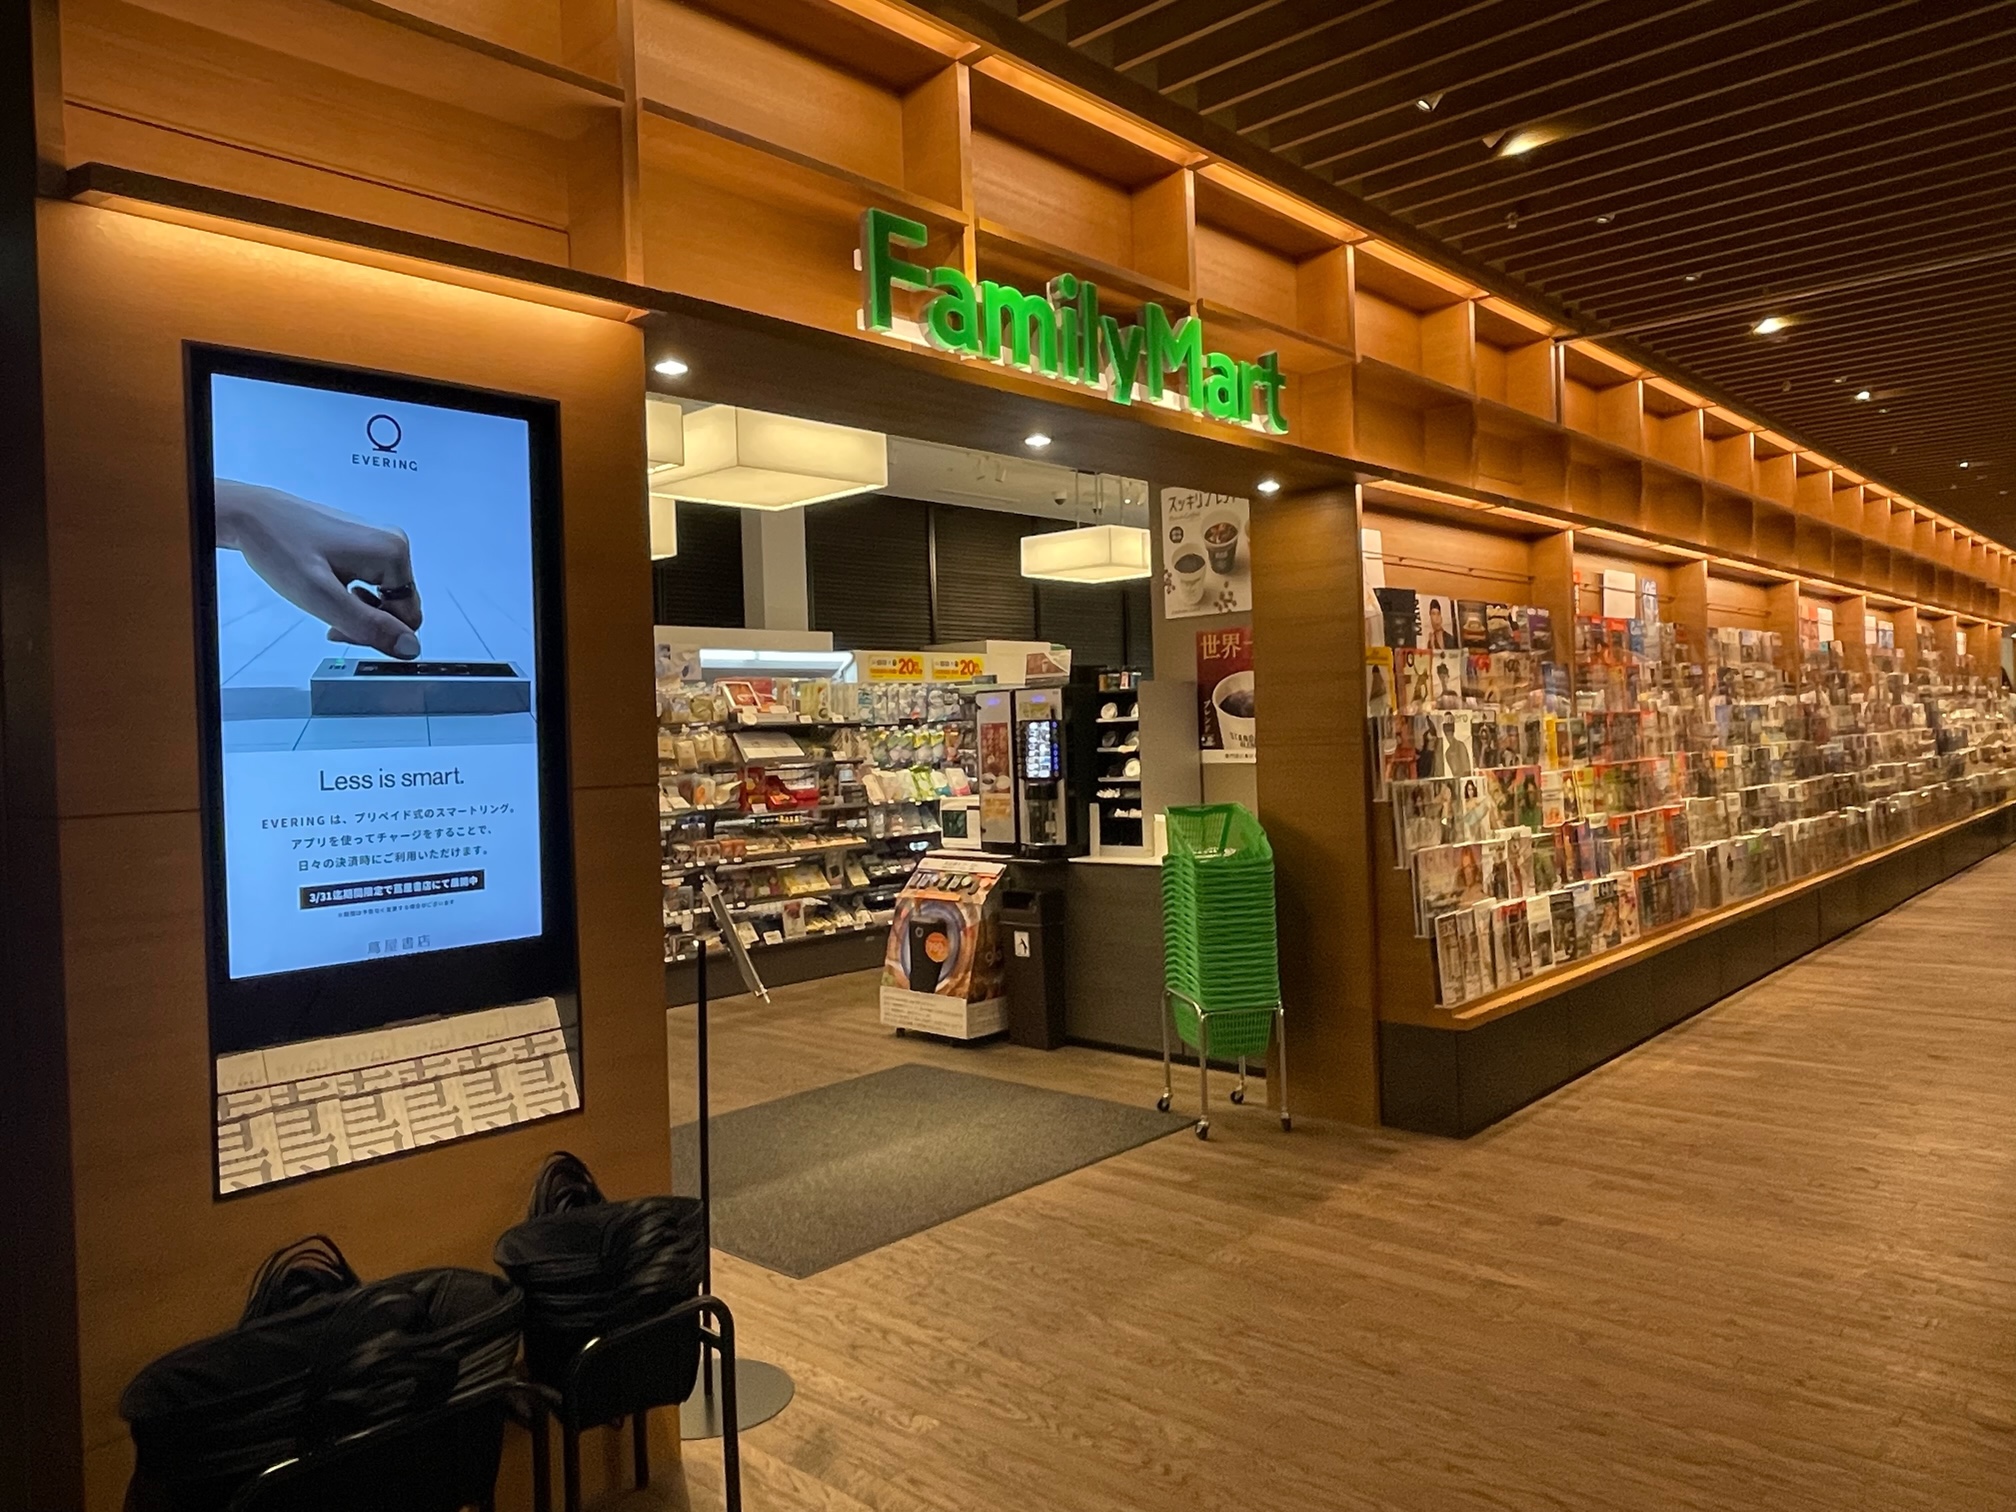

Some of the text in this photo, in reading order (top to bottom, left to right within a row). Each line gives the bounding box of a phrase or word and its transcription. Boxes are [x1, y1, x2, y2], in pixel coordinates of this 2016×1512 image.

[861, 206, 1289, 435] FamilyMart
[351, 453, 418, 472] EVERING
[319, 767, 465, 791] Less is smart.
[291, 824, 493, 850] アプリを使ってチャージをすることで、
[298, 845, 488, 872] 日々の決済時にご利用いただけます。
